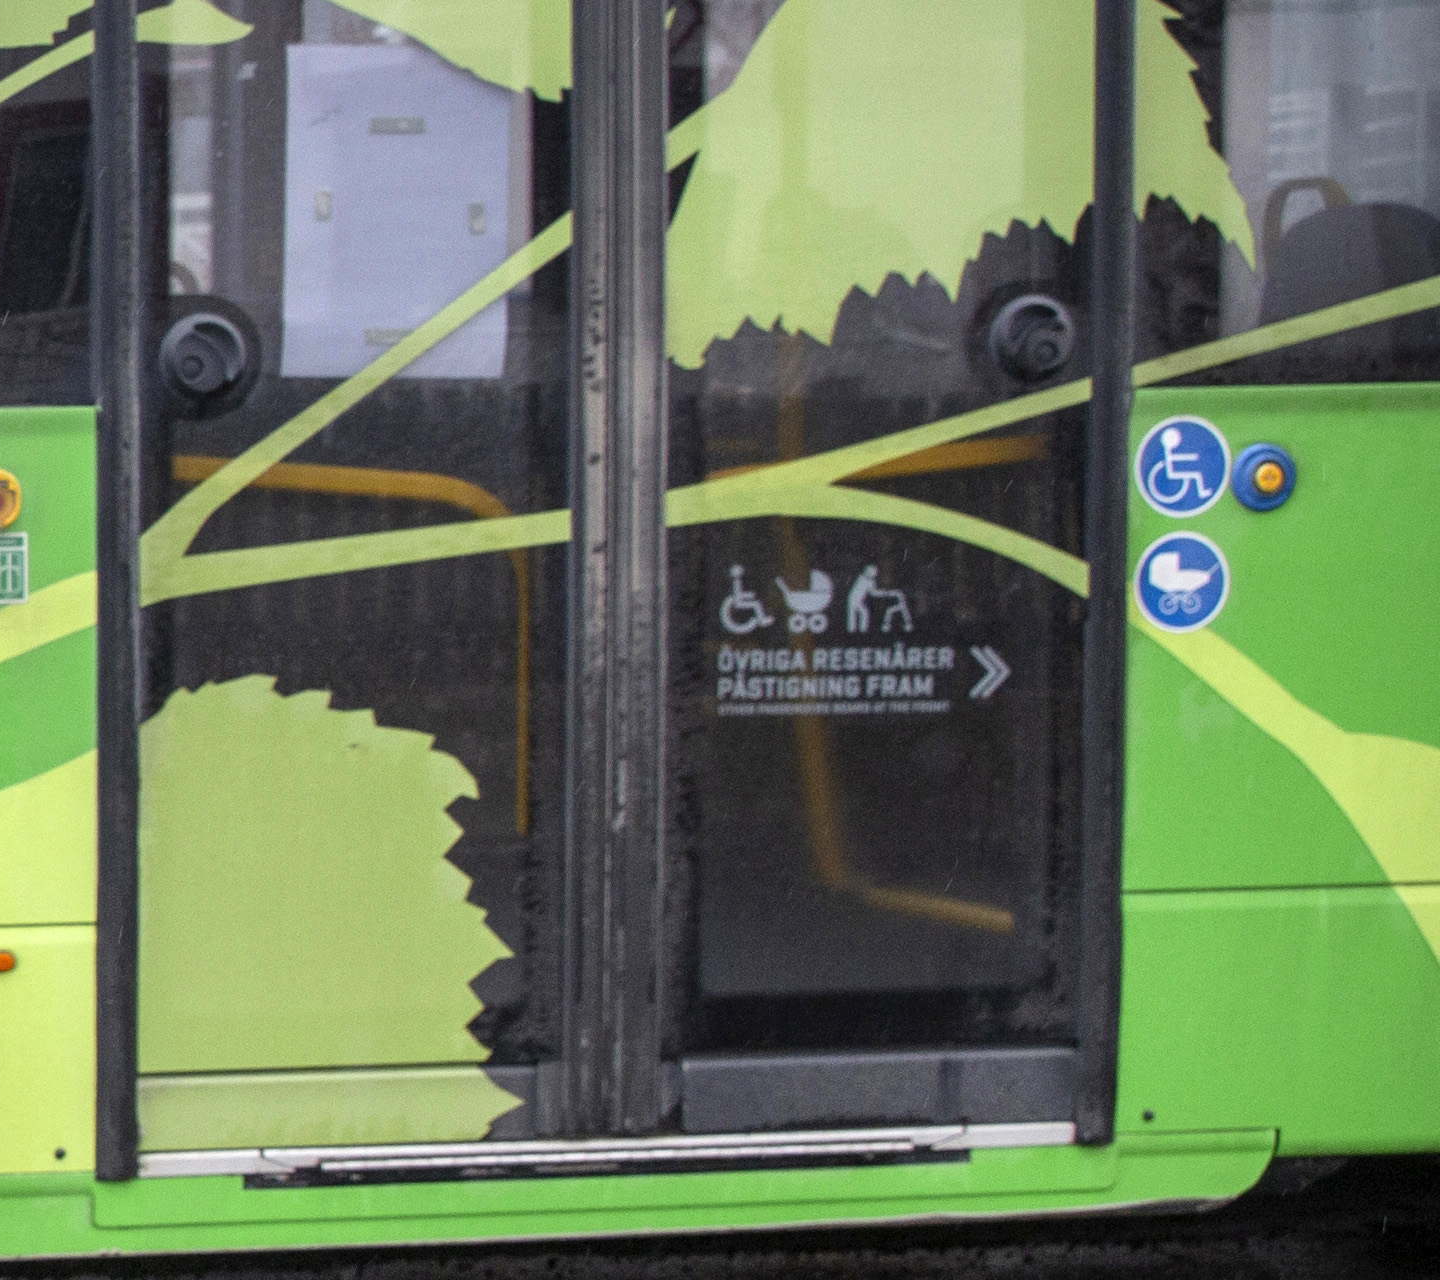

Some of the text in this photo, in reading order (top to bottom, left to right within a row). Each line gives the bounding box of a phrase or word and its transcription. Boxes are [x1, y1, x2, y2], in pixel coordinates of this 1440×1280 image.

[717, 642, 955, 671] ÖVRIGA RESENÄRER
[717, 669, 934, 700] PÅSTIGNING FRAM
